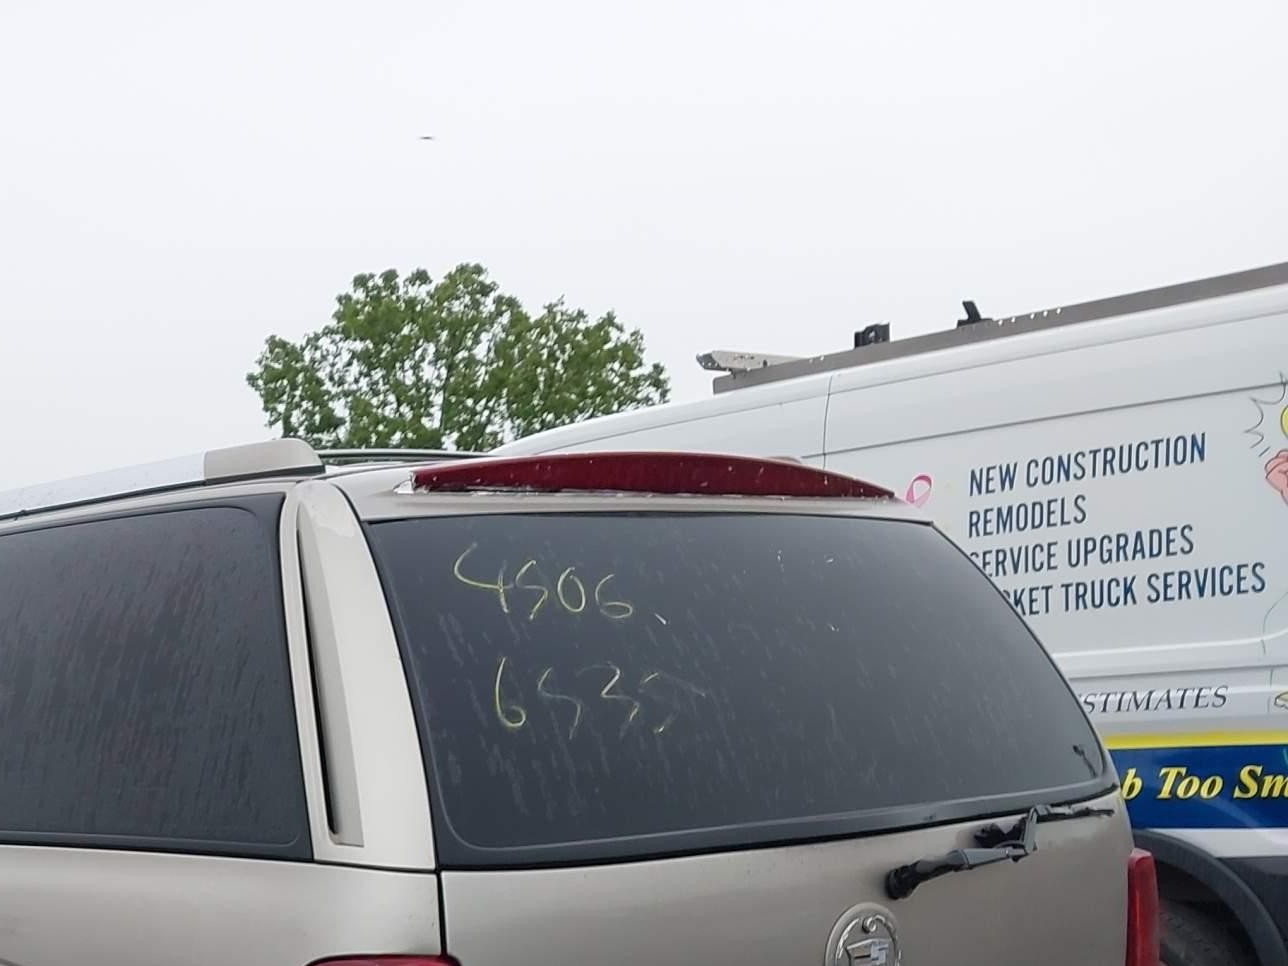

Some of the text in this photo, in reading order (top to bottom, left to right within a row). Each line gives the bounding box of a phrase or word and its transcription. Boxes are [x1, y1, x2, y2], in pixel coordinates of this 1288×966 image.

[969, 432, 1206, 497] NEW CONSTRUCTION
[968, 494, 1087, 538] REMODELS
[1067, 524, 1194, 568] UPGRADES
[1060, 575, 1137, 612] TRUCK
[1147, 562, 1266, 603] SERVICES
[1078, 685, 1230, 714] STIMATES
[1156, 767, 1224, 800] Too
